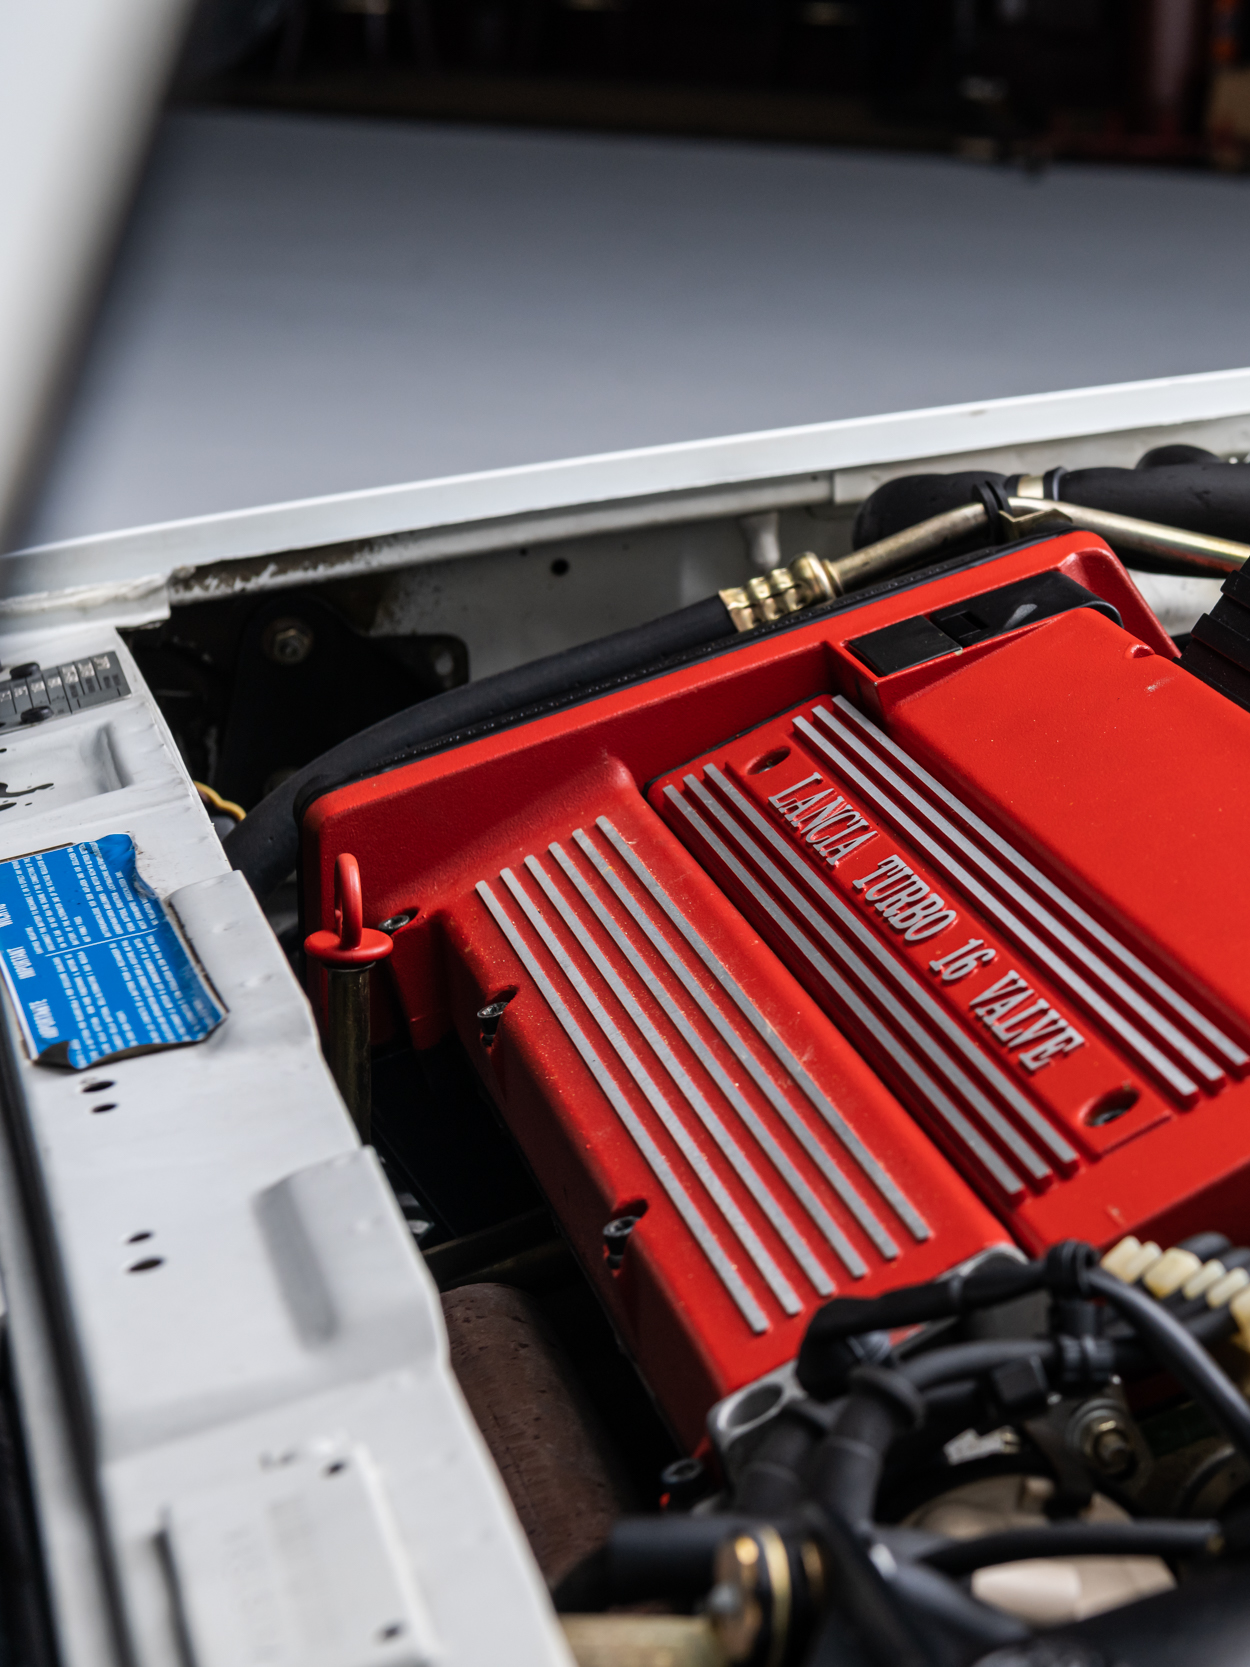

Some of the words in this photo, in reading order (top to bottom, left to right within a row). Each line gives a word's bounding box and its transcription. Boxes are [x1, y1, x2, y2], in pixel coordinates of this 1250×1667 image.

[768, 772, 878, 866] LANCIA
[852, 854, 957, 941] TURBO
[929, 939, 996, 981] 16
[969, 969, 1085, 1071] VALVE
